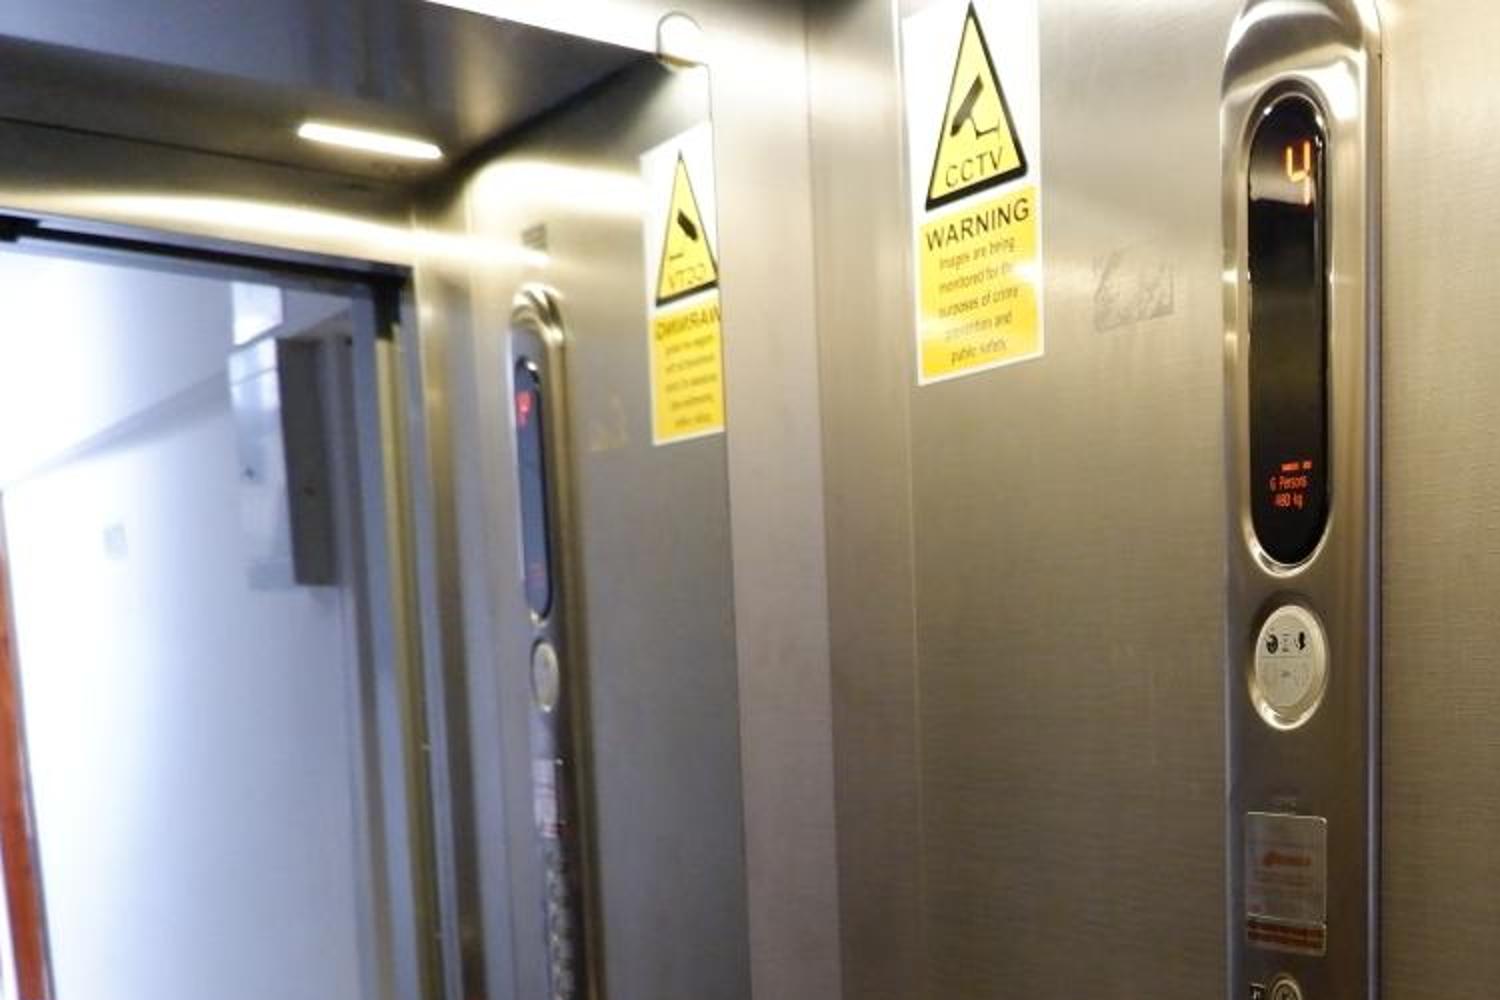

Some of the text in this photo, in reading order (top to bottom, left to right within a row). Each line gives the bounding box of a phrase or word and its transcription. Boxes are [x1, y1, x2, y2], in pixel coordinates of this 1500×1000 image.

[945, 145, 1003, 188] CCTV
[926, 197, 1029, 252] WARNING
[973, 245, 987, 261] are
[981, 290, 991, 307] of
